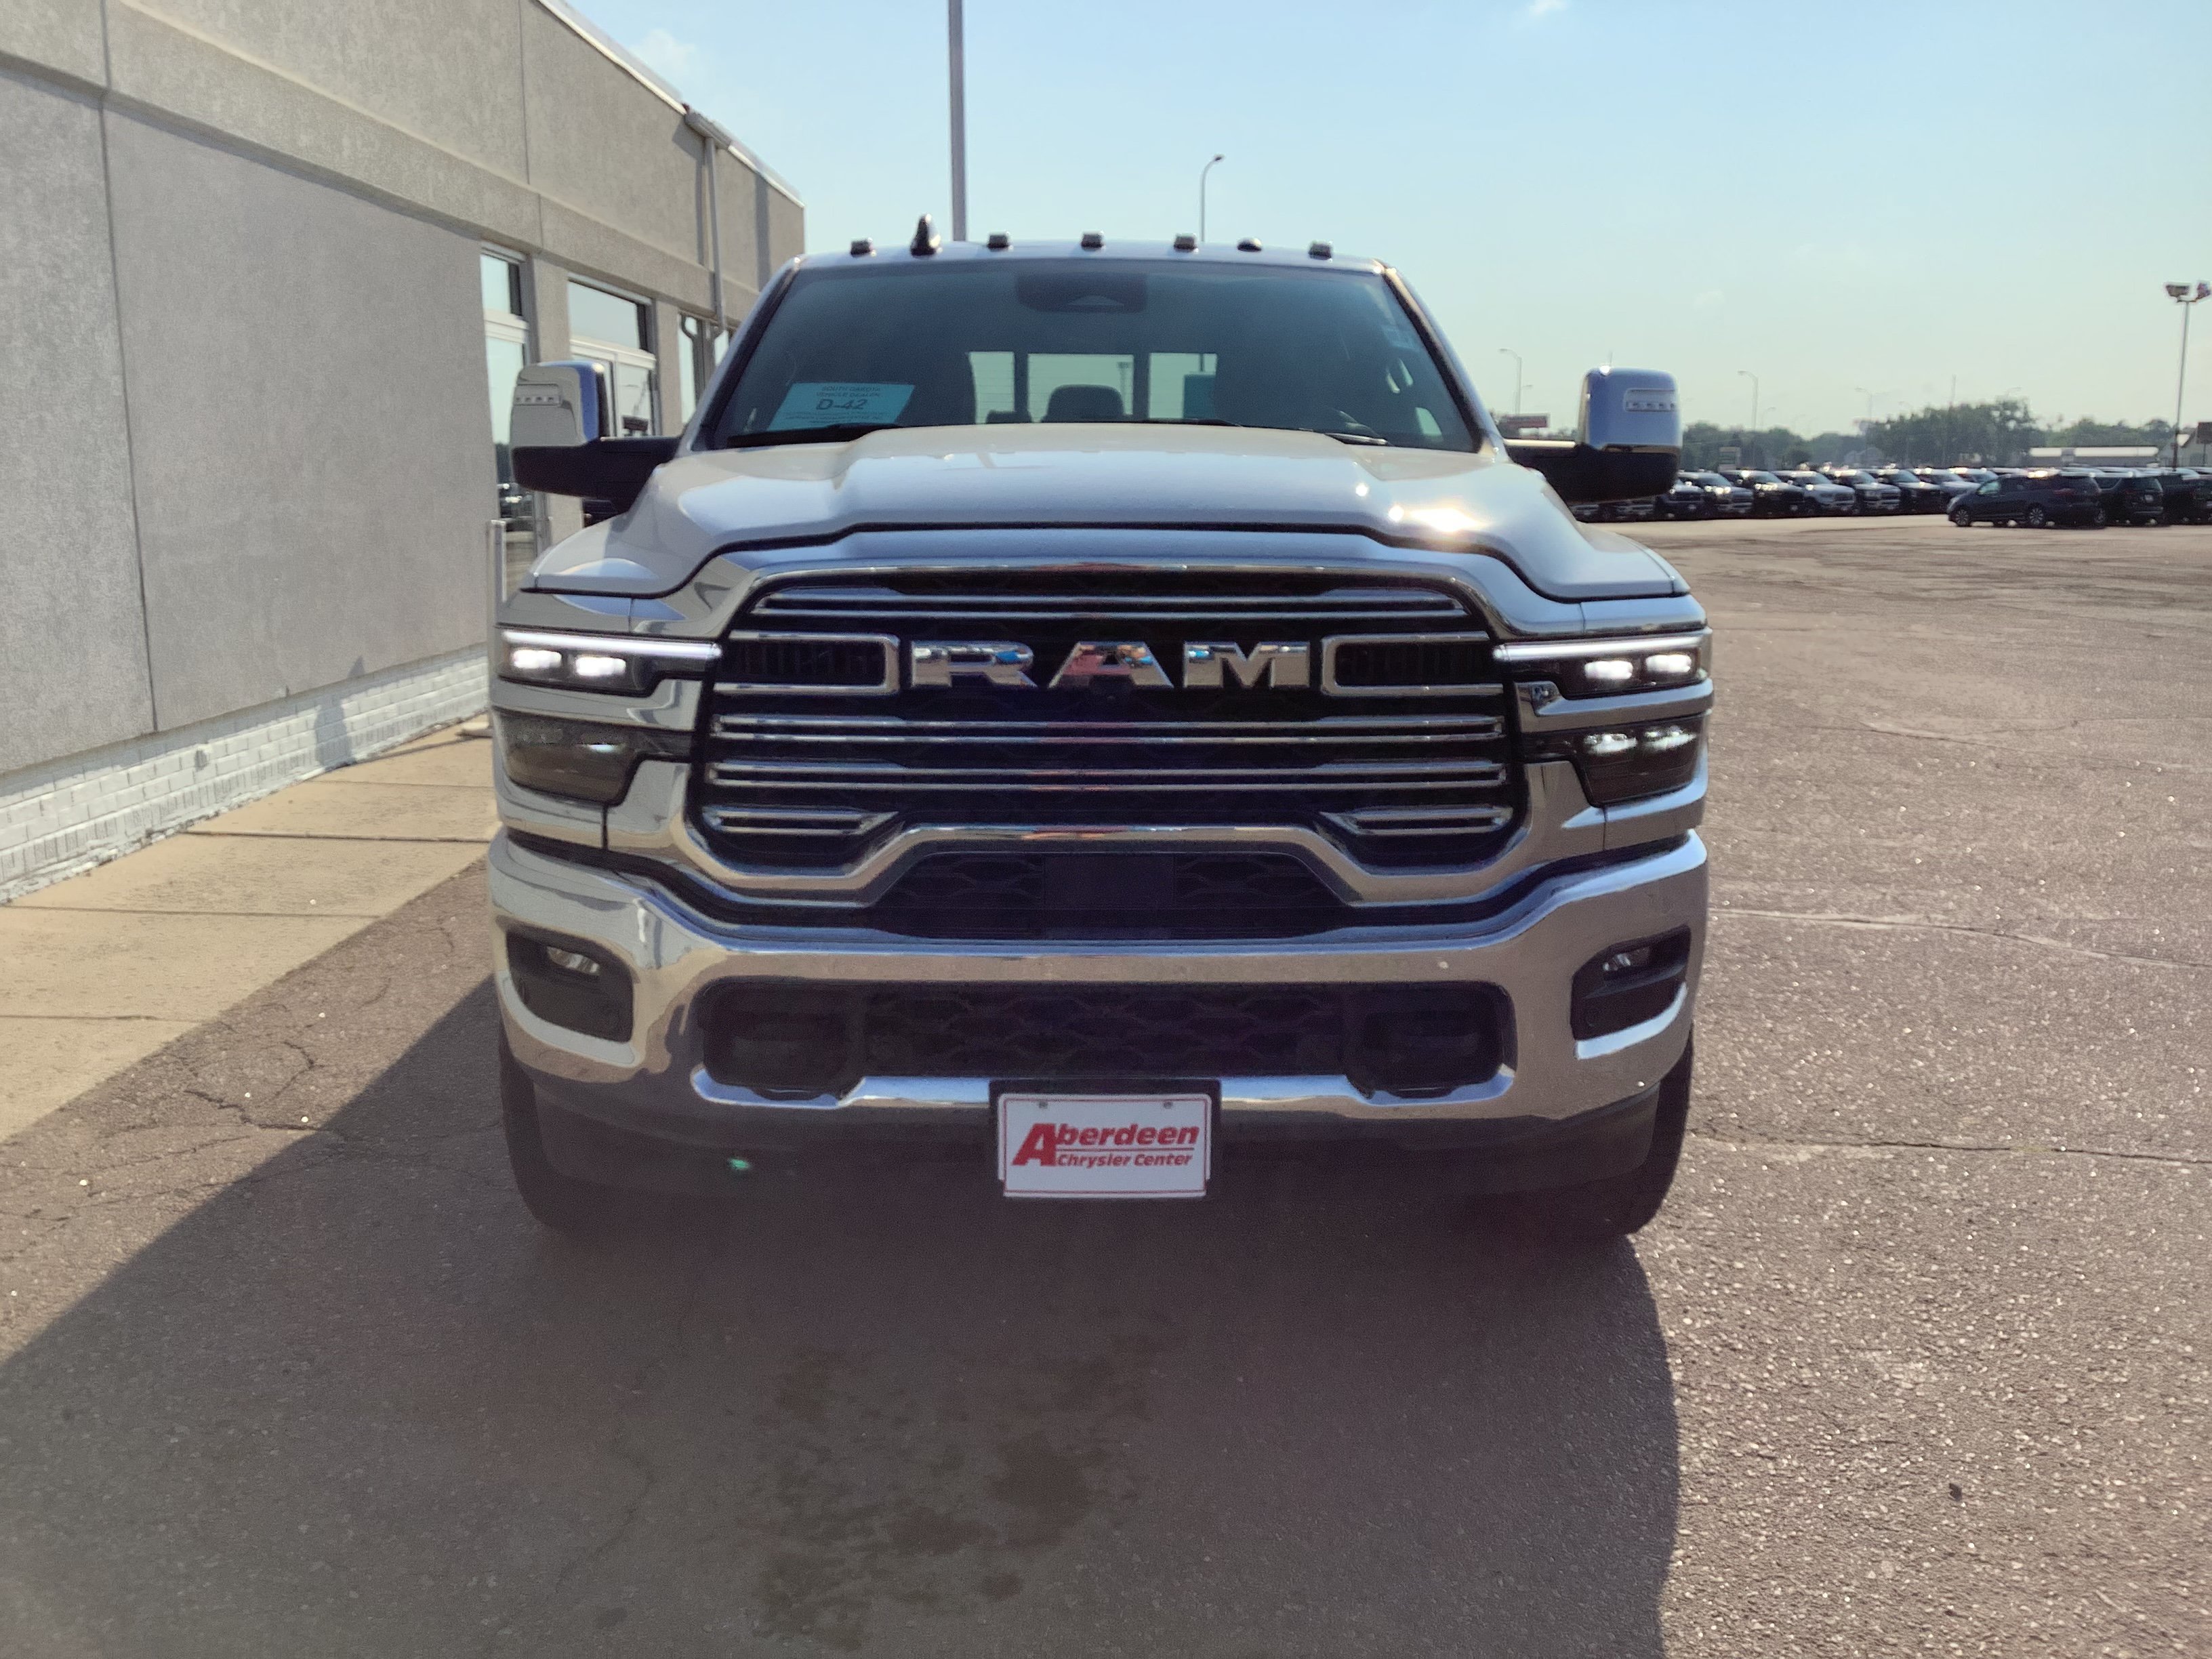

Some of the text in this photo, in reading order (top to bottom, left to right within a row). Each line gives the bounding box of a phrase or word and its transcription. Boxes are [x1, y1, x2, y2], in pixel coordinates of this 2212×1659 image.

[816, 398, 868, 410] D-42
[911, 640, 1311, 689] RAM
[1011, 1122, 1200, 1166] Aberdeen
[1056, 1153, 1193, 1168] Chrysler Center
